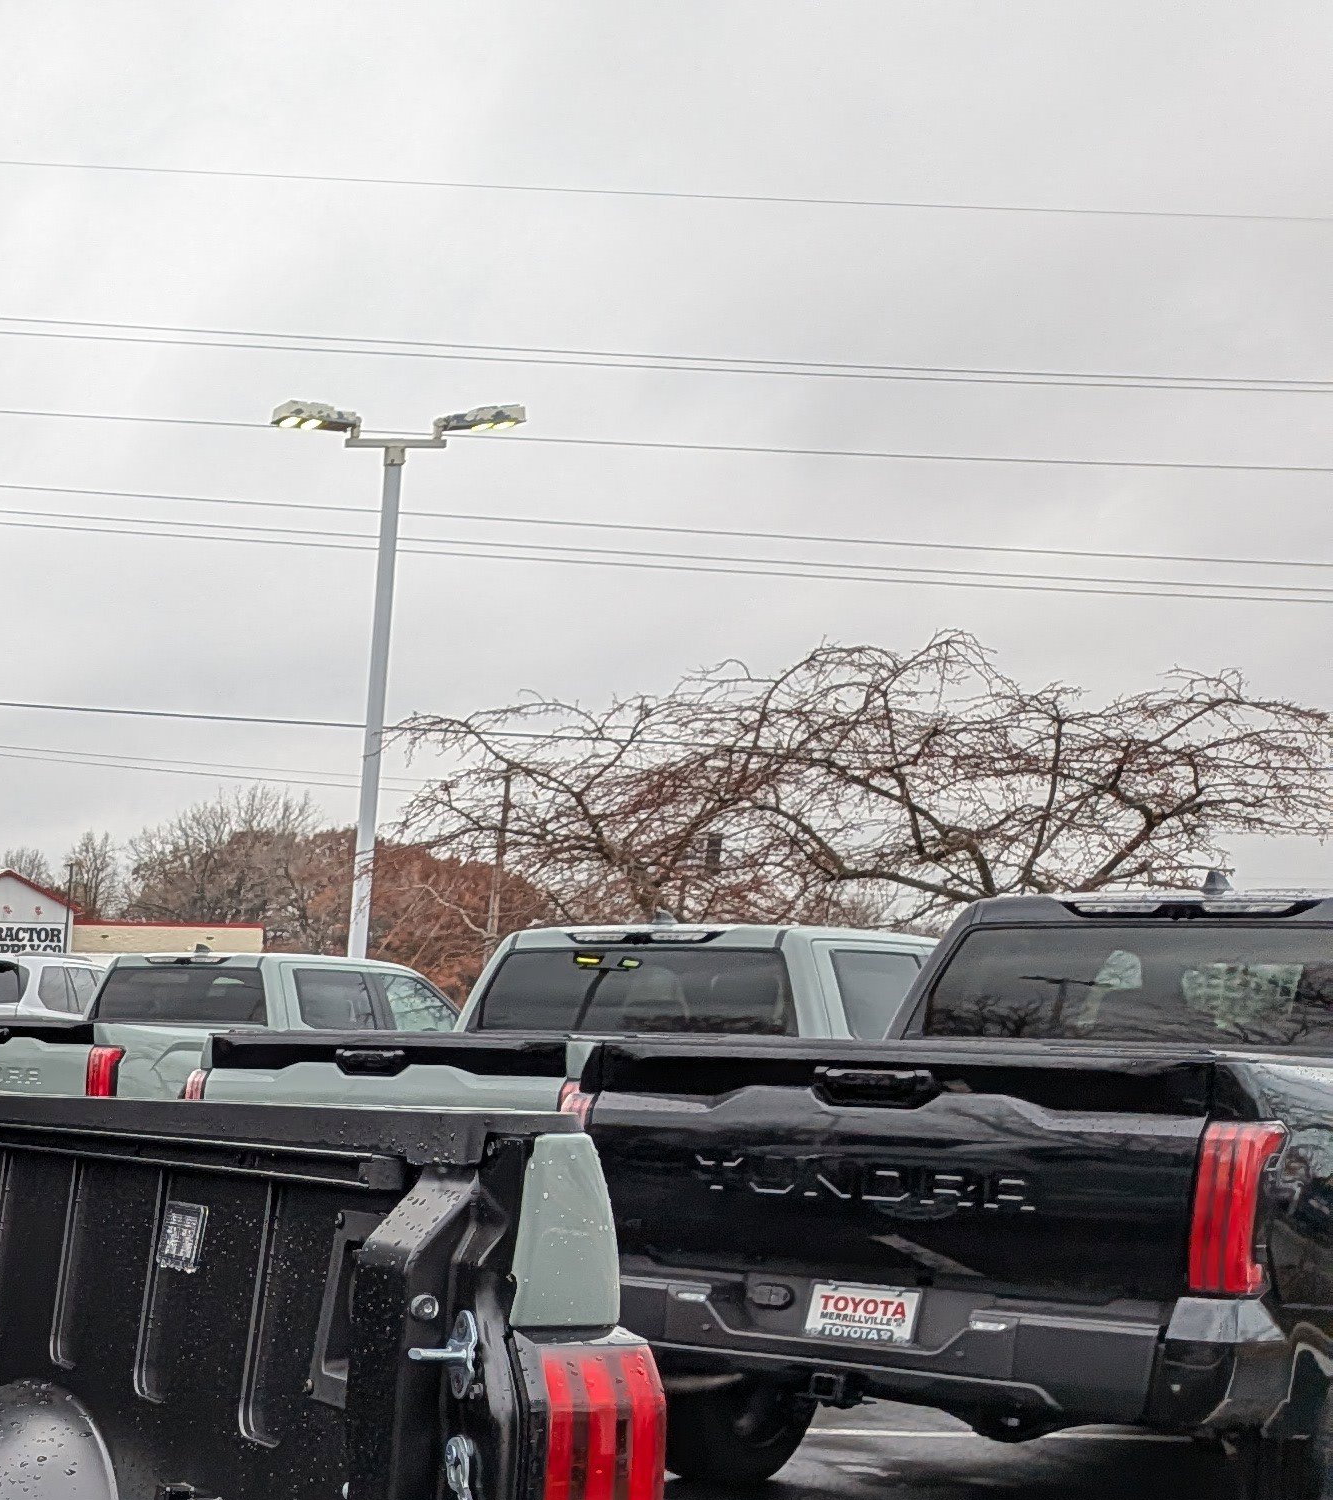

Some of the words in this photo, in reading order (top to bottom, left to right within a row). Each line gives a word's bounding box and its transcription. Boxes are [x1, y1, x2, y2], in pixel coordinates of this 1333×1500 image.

[694, 1153, 1036, 1212] TUNDRA
[820, 1294, 907, 1318] TOYOTA
[820, 1311, 893, 1326] MERRILLVILLE
[823, 1324, 879, 1340] TOYOTA
